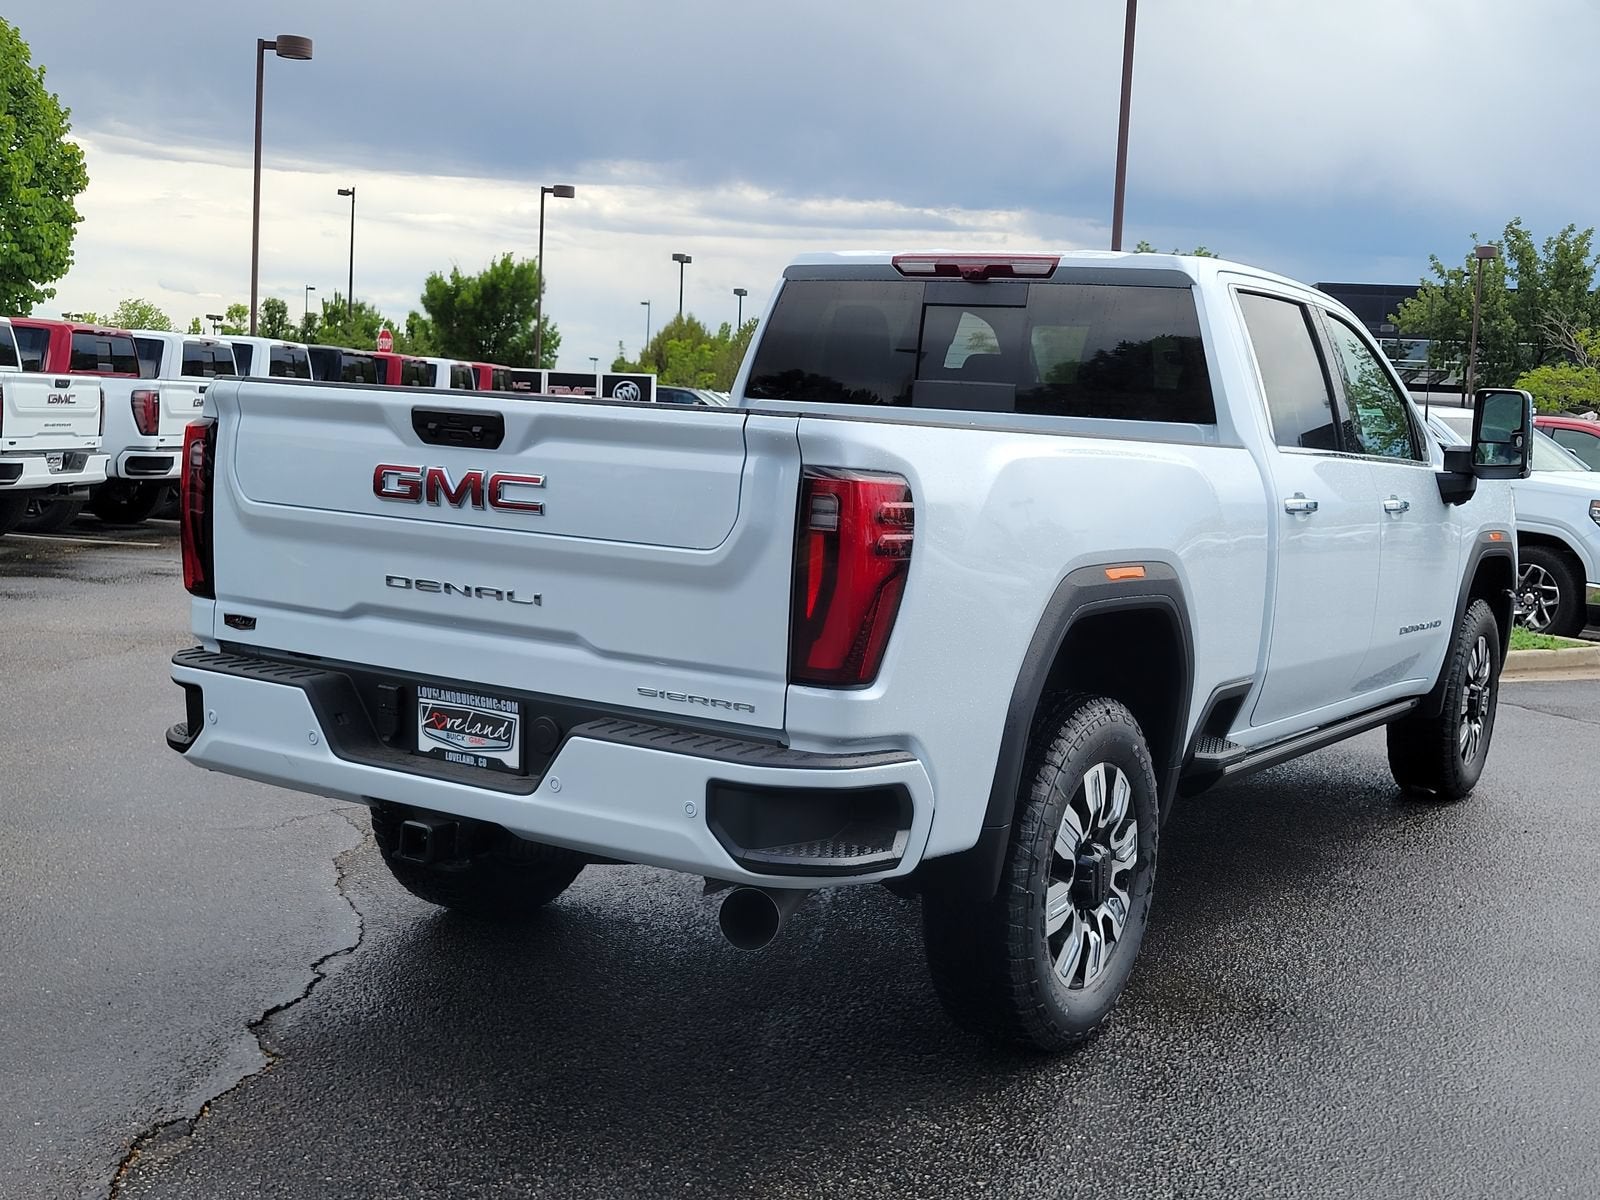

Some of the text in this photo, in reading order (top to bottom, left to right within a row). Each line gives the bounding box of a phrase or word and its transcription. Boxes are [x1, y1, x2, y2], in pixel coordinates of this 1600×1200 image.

[379, 337, 392, 349] STOP
[512, 381, 531, 389] MC
[47, 394, 77, 404] GMC
[373, 463, 547, 516] GMC
[385, 574, 542, 606] DENALI
[637, 686, 755, 713] SIERRA
[421, 703, 510, 740] Loveland
[446, 732, 487, 746] BUICK GMC
[478, 758, 488, 768] CO
